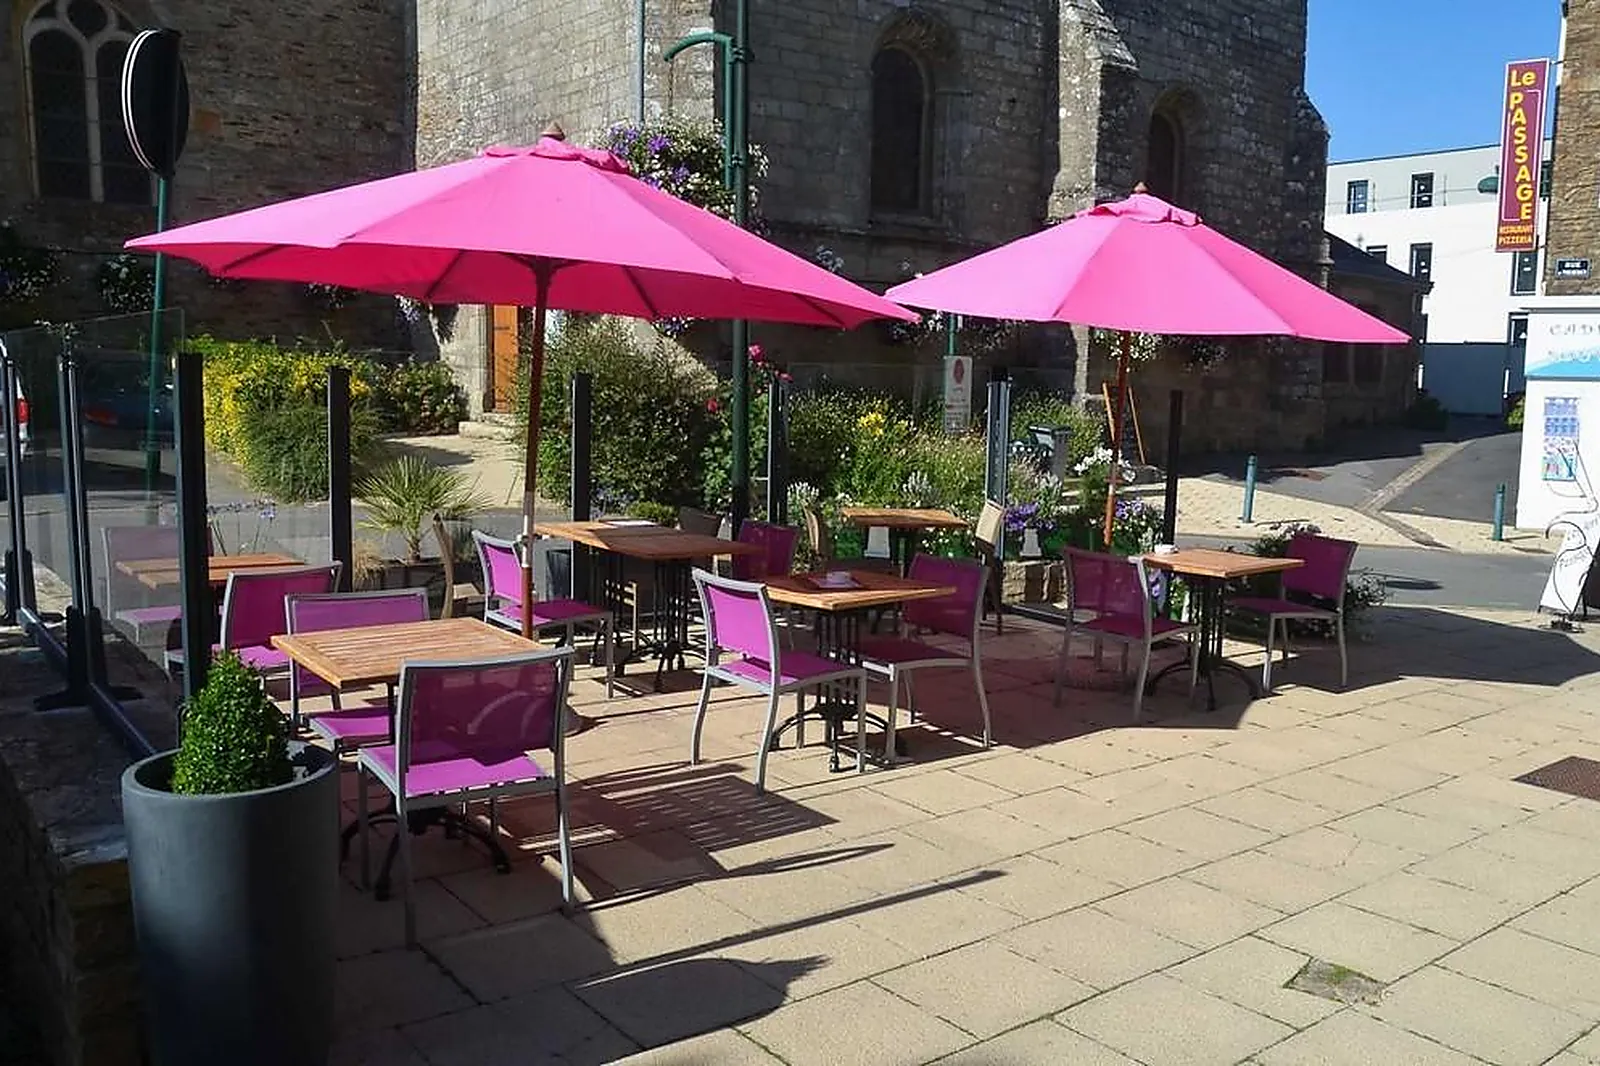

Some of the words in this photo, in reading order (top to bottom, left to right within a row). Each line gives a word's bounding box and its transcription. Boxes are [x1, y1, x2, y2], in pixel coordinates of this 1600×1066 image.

[1510, 69, 1536, 87] Le
[1509, 91, 1534, 220] PASSAGE
[1498, 235, 1533, 245] PIZZERIA
